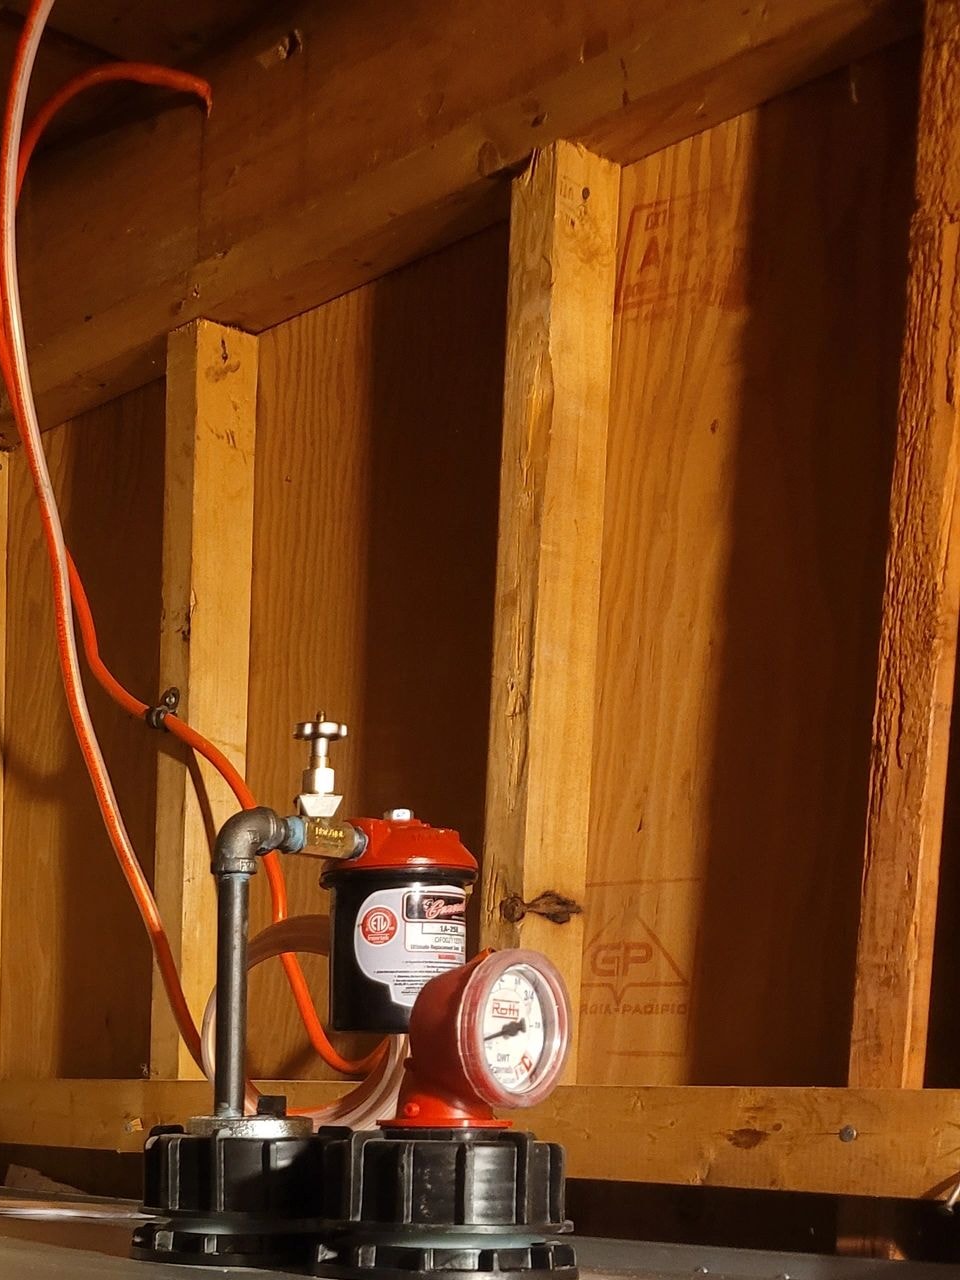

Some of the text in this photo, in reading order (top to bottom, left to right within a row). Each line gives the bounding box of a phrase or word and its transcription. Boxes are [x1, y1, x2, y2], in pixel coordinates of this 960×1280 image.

[591, 941, 653, 977] GP
[491, 1002, 519, 1017] Roth
[580, 1002, 688, 1016] RGIA-PACIFIC
